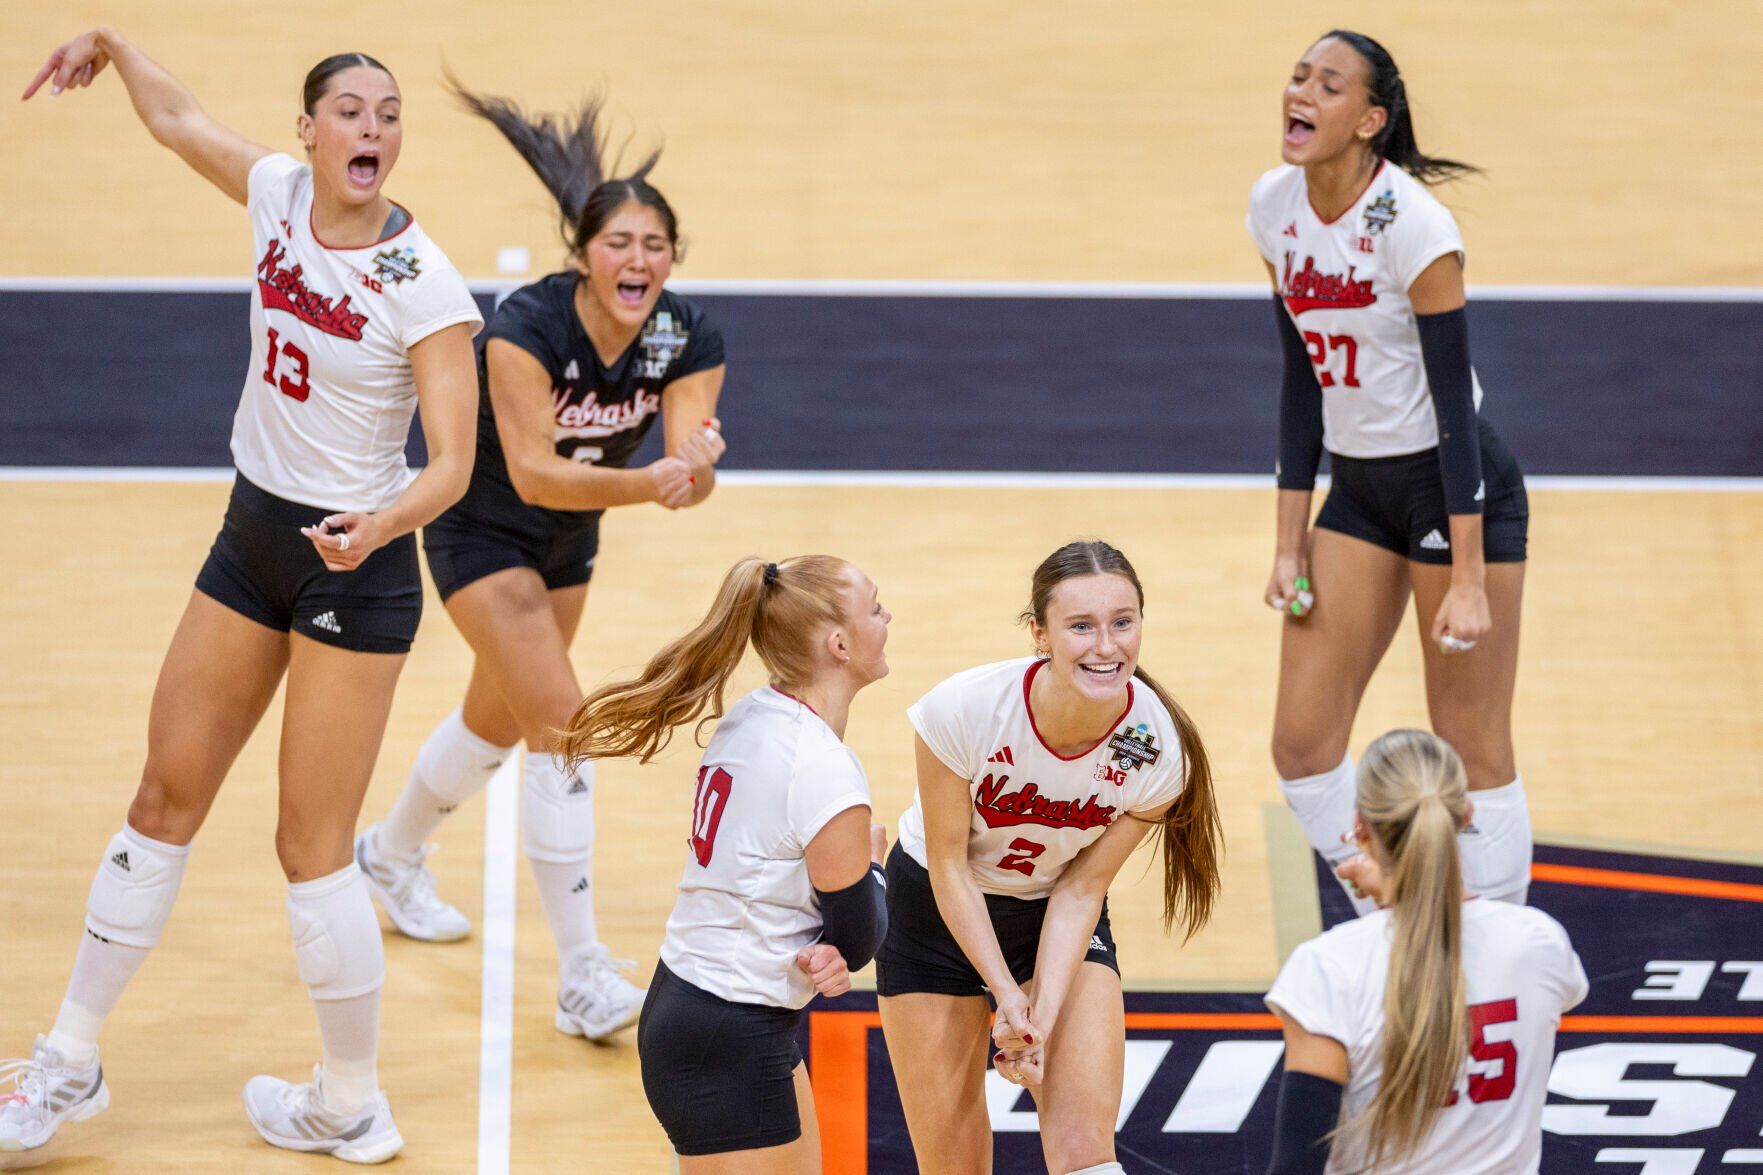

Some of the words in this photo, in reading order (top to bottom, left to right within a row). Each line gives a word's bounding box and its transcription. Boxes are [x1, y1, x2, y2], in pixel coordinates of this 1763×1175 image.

[258, 238, 369, 339] Nebraska
[262, 326, 312, 403] 13
[1303, 330, 1361, 388] 27
[1111, 739, 1155, 761] CHAMPIONSHIP
[975, 773, 1117, 826] Nebraska
[996, 837, 1047, 877] 2
[1446, 997, 1518, 1106] 5
